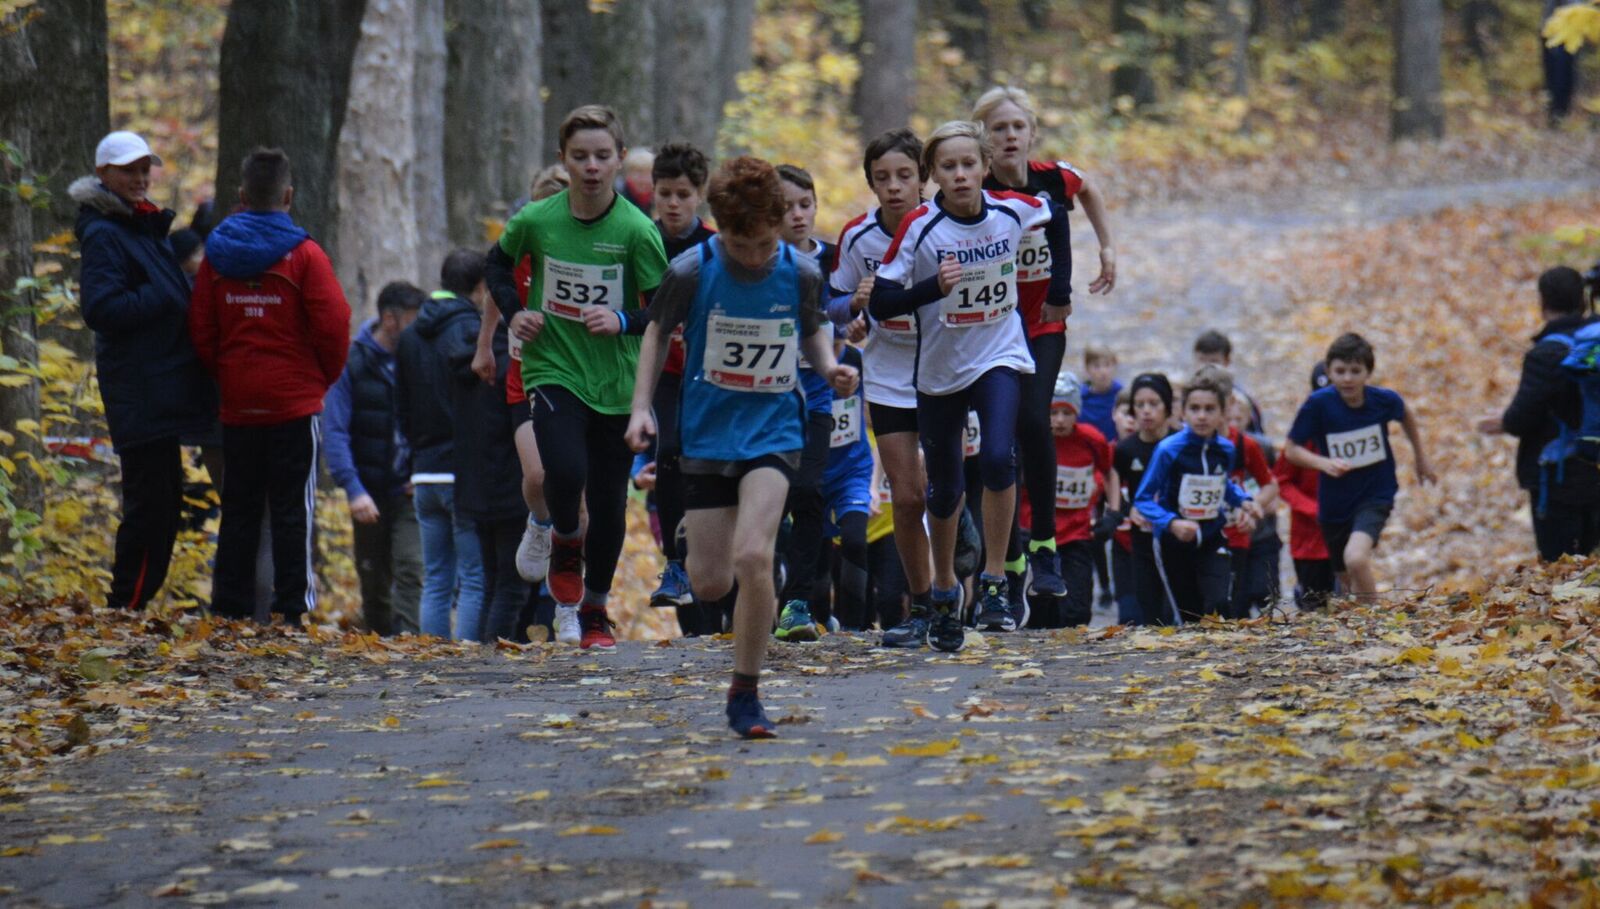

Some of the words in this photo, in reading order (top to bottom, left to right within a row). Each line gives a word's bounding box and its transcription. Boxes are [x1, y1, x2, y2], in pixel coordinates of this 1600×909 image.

[956, 235, 993, 248] TEAM
[555, 279, 609, 305] 532
[957, 281, 1008, 309] 149
[714, 327, 760, 337] WINDBERG
[722, 342, 786, 370] 377
[1330, 434, 1381, 459] 1073
[1189, 488, 1220, 506] 339
